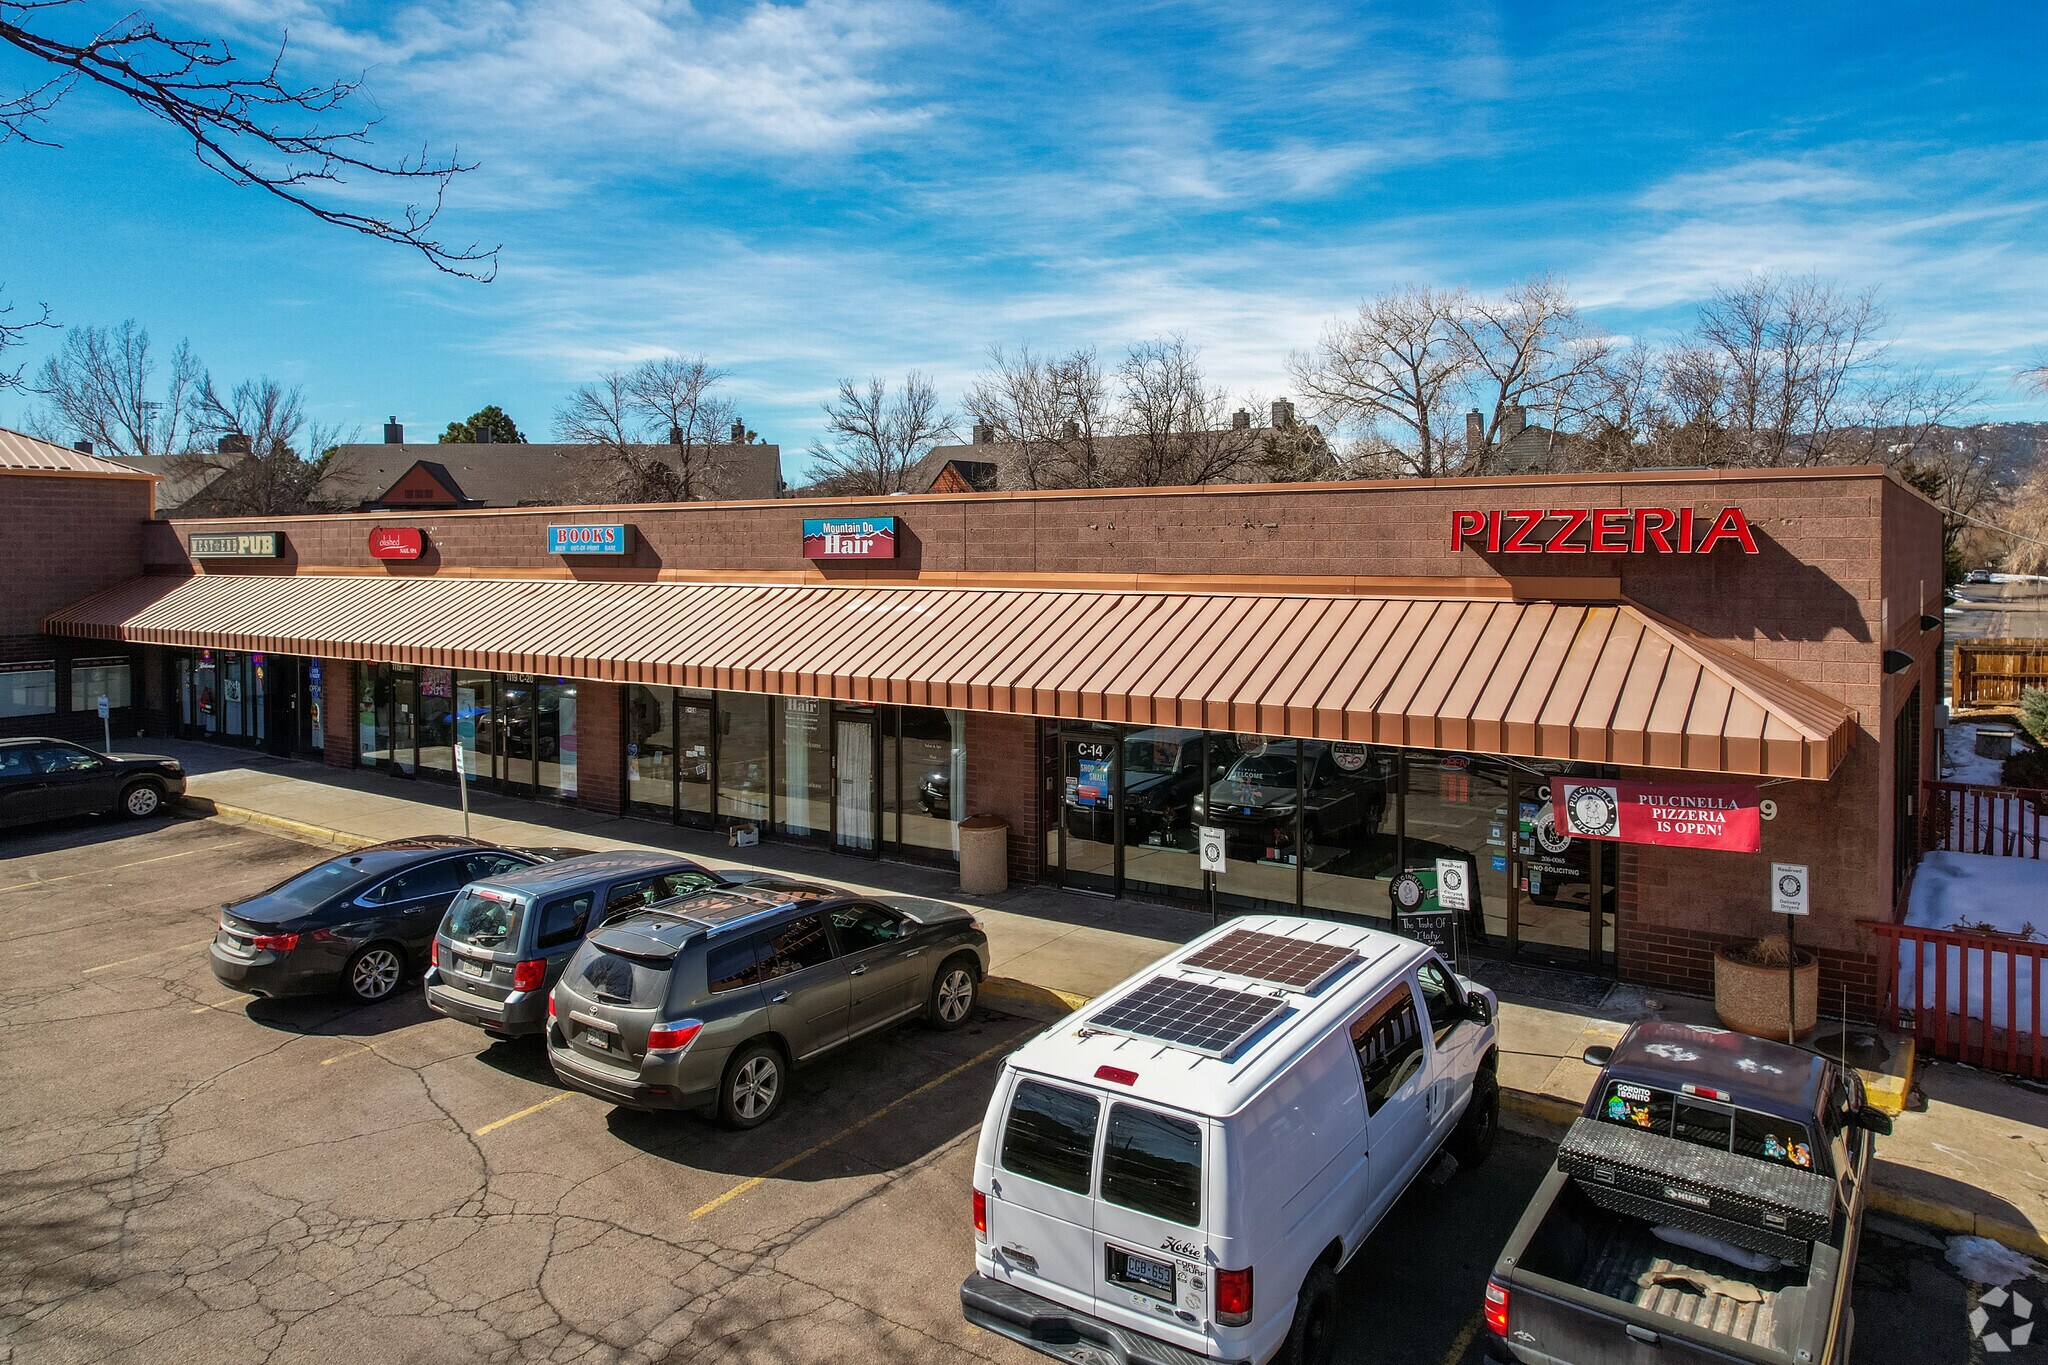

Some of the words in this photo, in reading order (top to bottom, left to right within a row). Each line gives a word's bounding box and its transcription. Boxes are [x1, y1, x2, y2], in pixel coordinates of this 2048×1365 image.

[557, 527, 615, 543] BOOKS
[823, 522, 860, 533] Mountain
[862, 522, 874, 533] Do
[1450, 506, 1759, 554] PIZZERIA
[191, 539, 214, 551] WEST
[220, 539, 237, 551] END
[238, 536, 273, 554] PUB
[823, 534, 874, 554] Hair
[506, 673, 518, 682] 1119
[787, 698, 817, 713] Hair
[1078, 742, 1103, 757] C-14
[1080, 763, 1095, 773] SHOP
[1441, 757, 1468, 769] OPEN
[1088, 772, 1106, 782] SMALL
[1569, 786, 1615, 811] PULCINELLA
[1638, 794, 1740, 810] PULCINELLA
[1652, 808, 1727, 823] PIZZERIA
[1574, 820, 1614, 836] PIZZERIA
[1657, 822, 1671, 832] IS
[1672, 822, 1723, 836] OPEN!
[1541, 839, 1568, 852] PIZZERIA
[1544, 866, 1580, 875] SOLICITING
[1392, 874, 1423, 891] PULCINELLA
[1401, 918, 1414, 929] The
[1416, 917, 1433, 929] Taste
[1435, 917, 1446, 929] Of
[1413, 929, 1440, 940] Italy
[1617, 1084, 1651, 1096] GORDITO
[1677, 1191, 1710, 1206] HUSKY
[1160, 1236, 1200, 1260] Hobie
[1183, 1265, 1206, 1277] SURF
